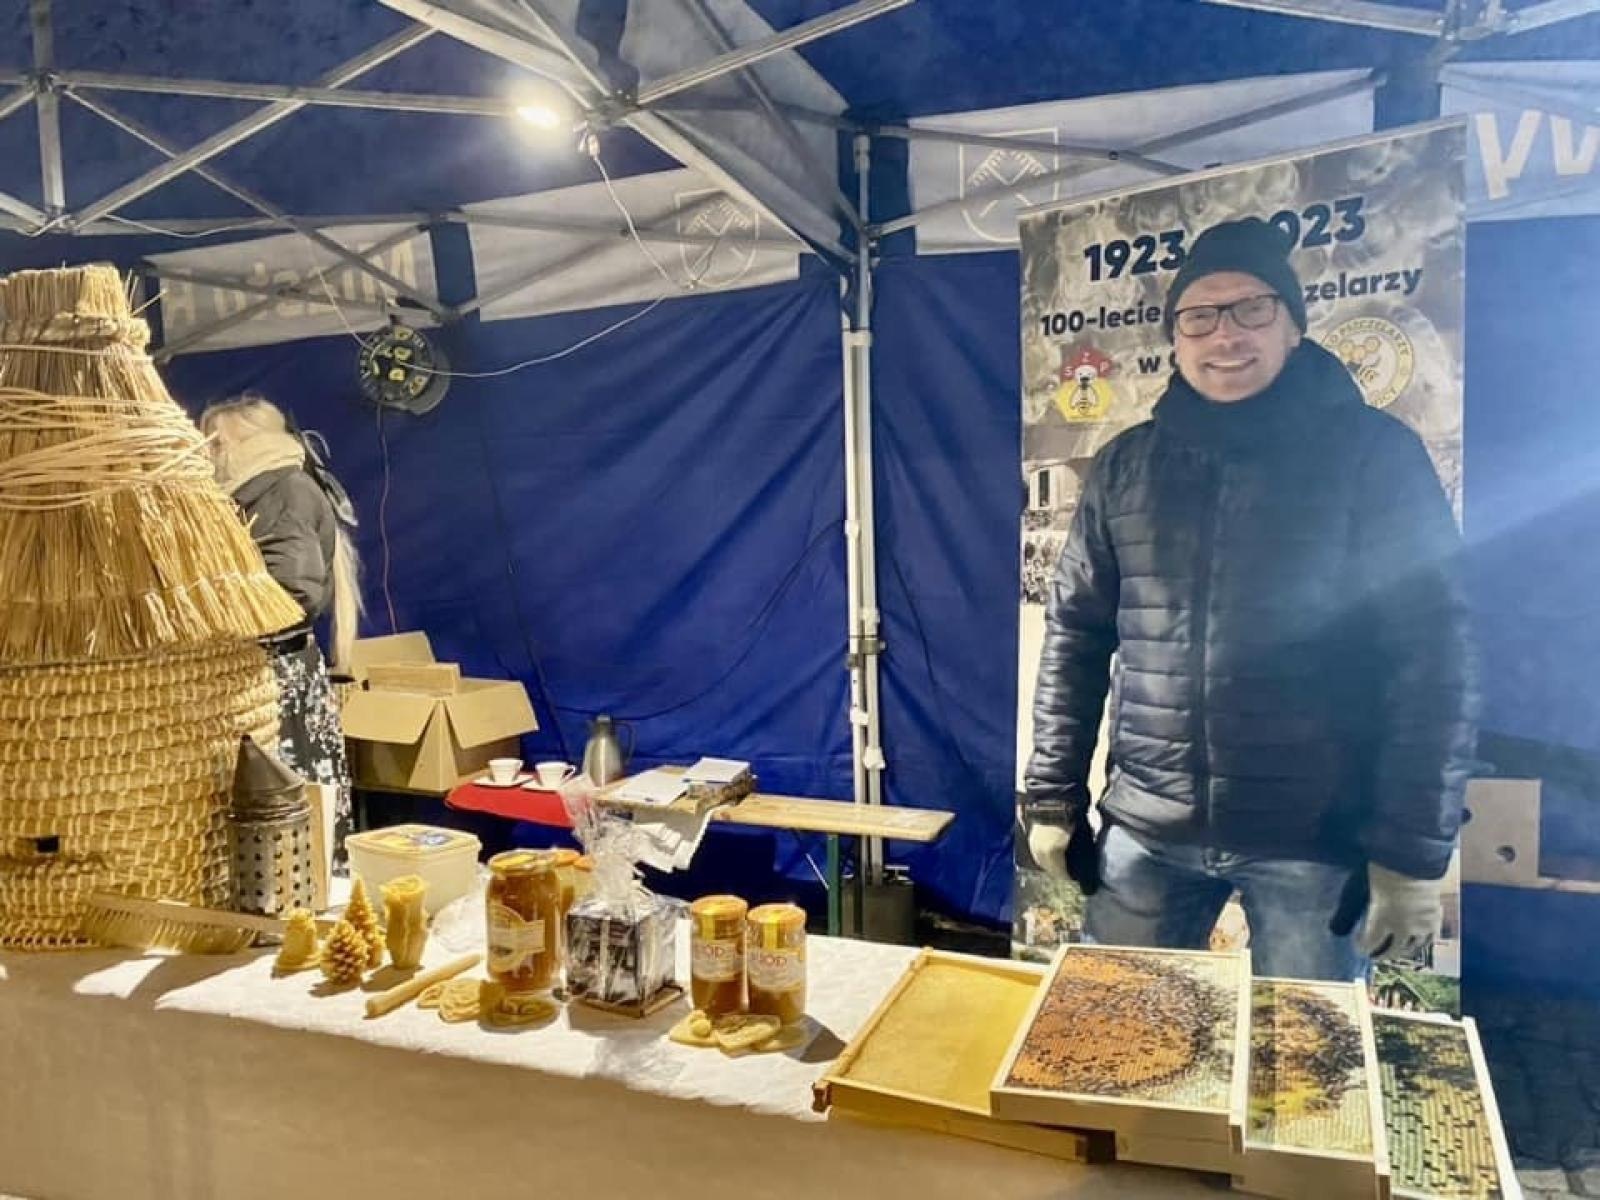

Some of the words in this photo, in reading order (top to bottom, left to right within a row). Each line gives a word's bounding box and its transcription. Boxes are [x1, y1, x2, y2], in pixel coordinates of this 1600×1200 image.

[1084, 229, 1185, 282] 1923
[1270, 196, 1366, 250] 023
[1040, 300, 1161, 336] 100-lecie
[1304, 268, 1423, 303] zelarzy
[1137, 354, 1161, 374] w
